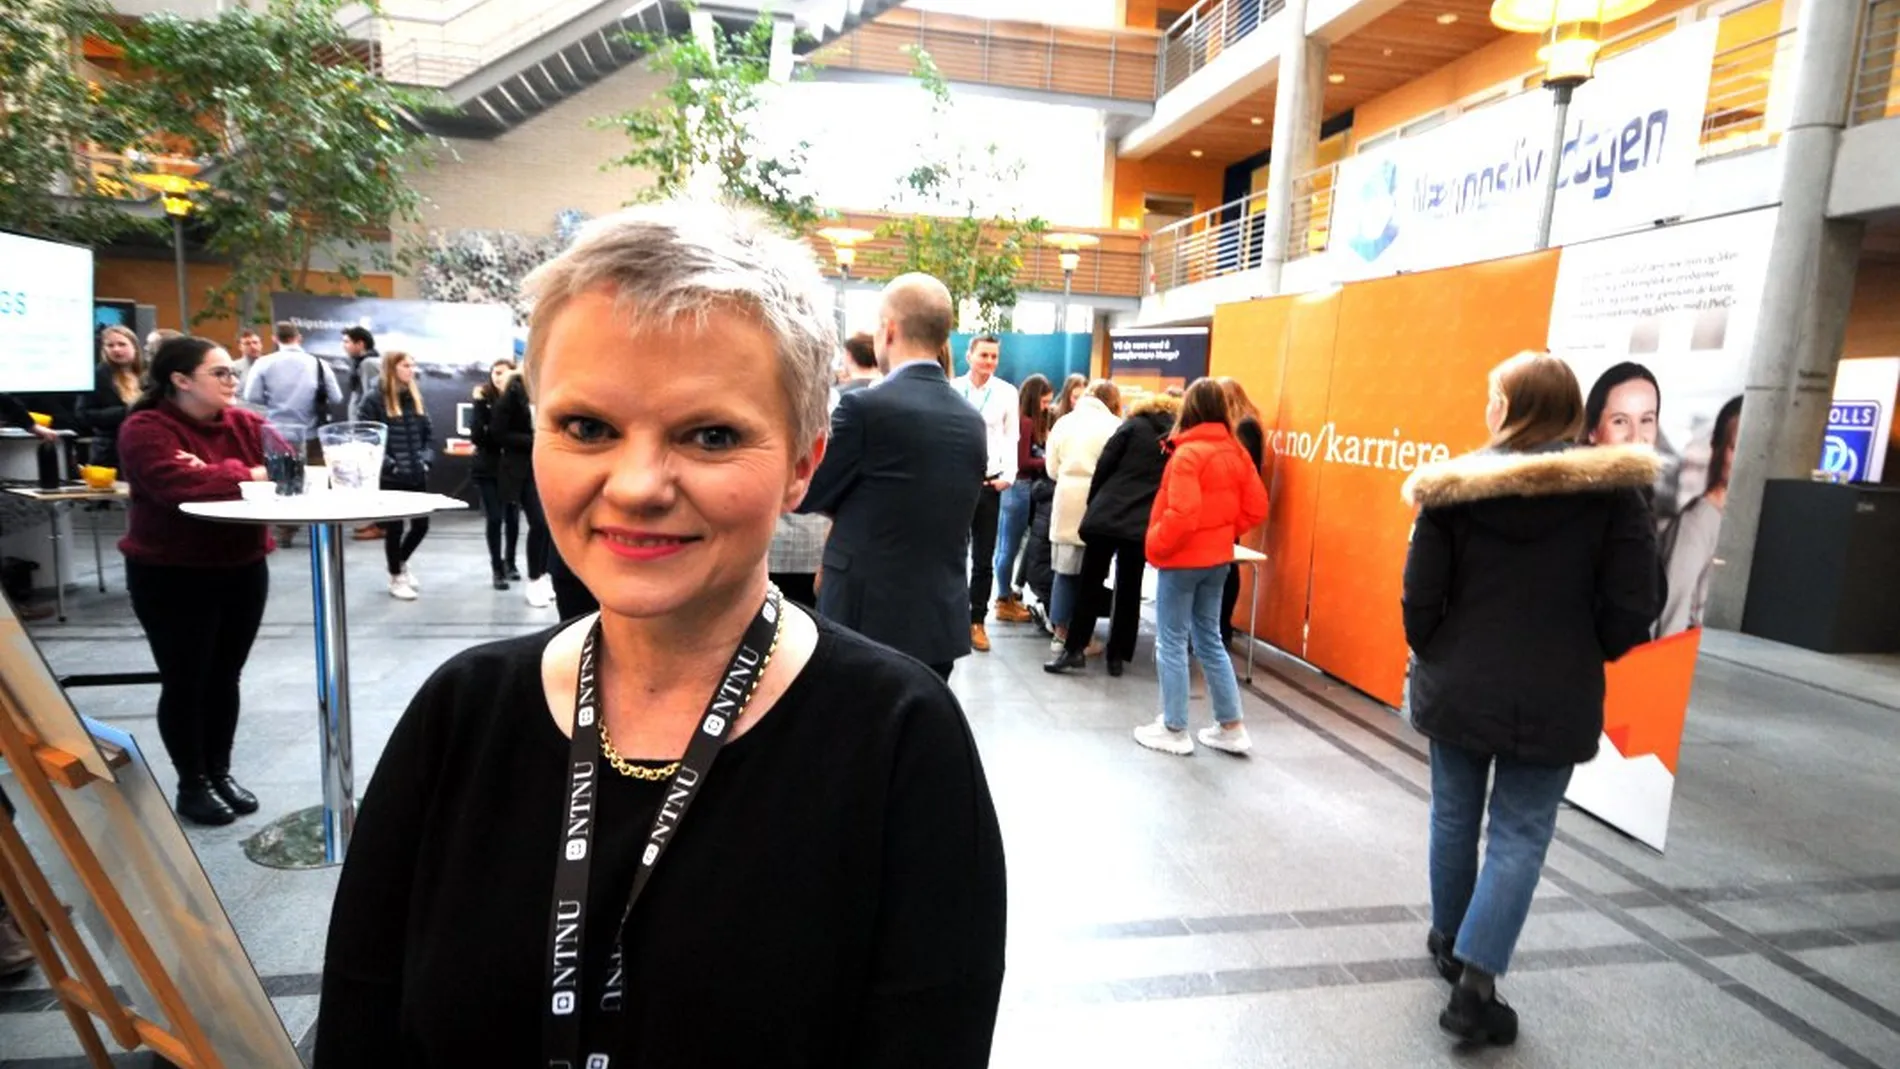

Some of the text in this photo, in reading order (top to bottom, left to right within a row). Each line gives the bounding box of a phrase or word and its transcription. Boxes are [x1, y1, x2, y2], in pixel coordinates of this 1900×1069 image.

[712, 644, 760, 717] NTNU
[567, 760, 595, 837] NTNU
[651, 766, 699, 843] NTNU
[552, 899, 581, 988] NTNU
